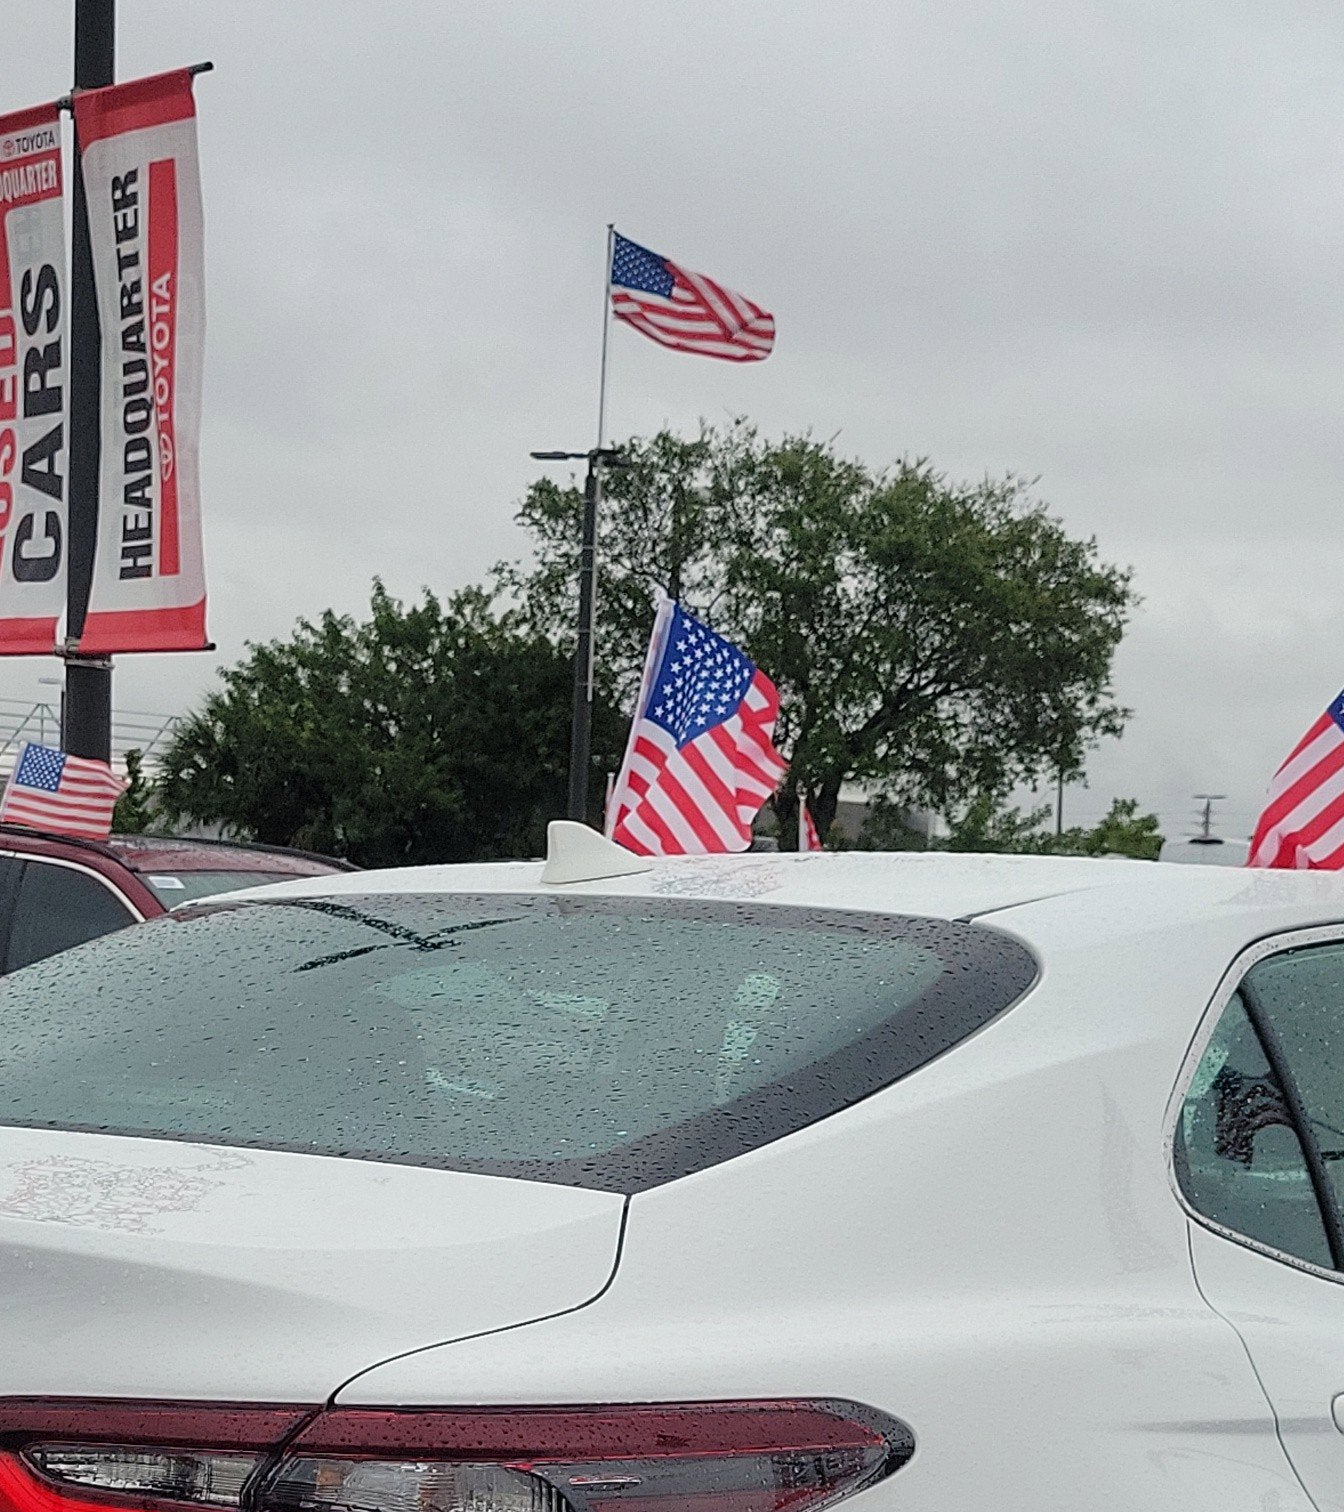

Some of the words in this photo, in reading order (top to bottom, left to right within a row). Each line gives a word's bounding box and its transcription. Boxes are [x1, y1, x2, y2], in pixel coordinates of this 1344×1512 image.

[15, 130, 56, 154] TOYOTA
[12, 263, 65, 582] CARS
[111, 166, 154, 580] HEADQUARTER
[151, 270, 173, 430] TOYOTA
